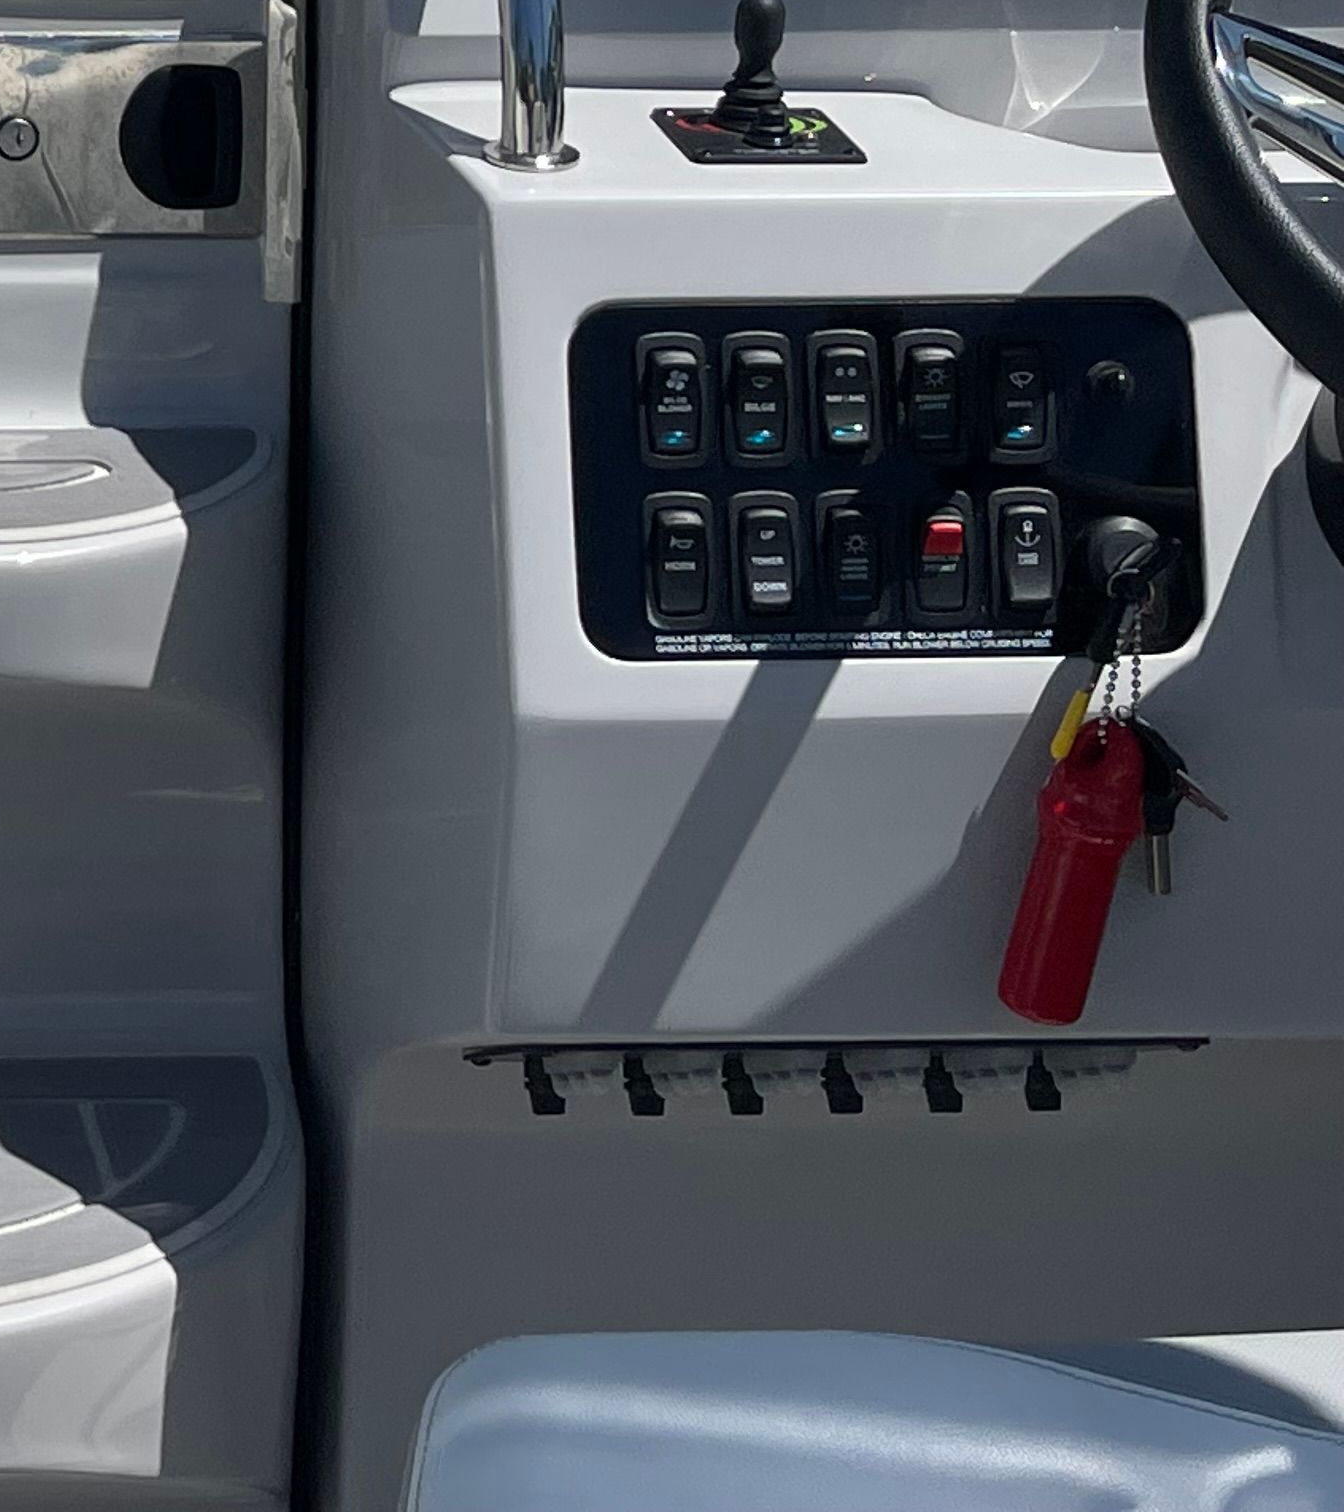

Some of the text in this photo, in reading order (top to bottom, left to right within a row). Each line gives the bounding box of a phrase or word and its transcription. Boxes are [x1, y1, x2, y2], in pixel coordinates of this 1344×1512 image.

[760, 529, 776, 541] UP
[753, 581, 788, 592] DOWN
[655, 634, 697, 643] GASOLINE
[655, 643, 697, 652] GASOLINE
